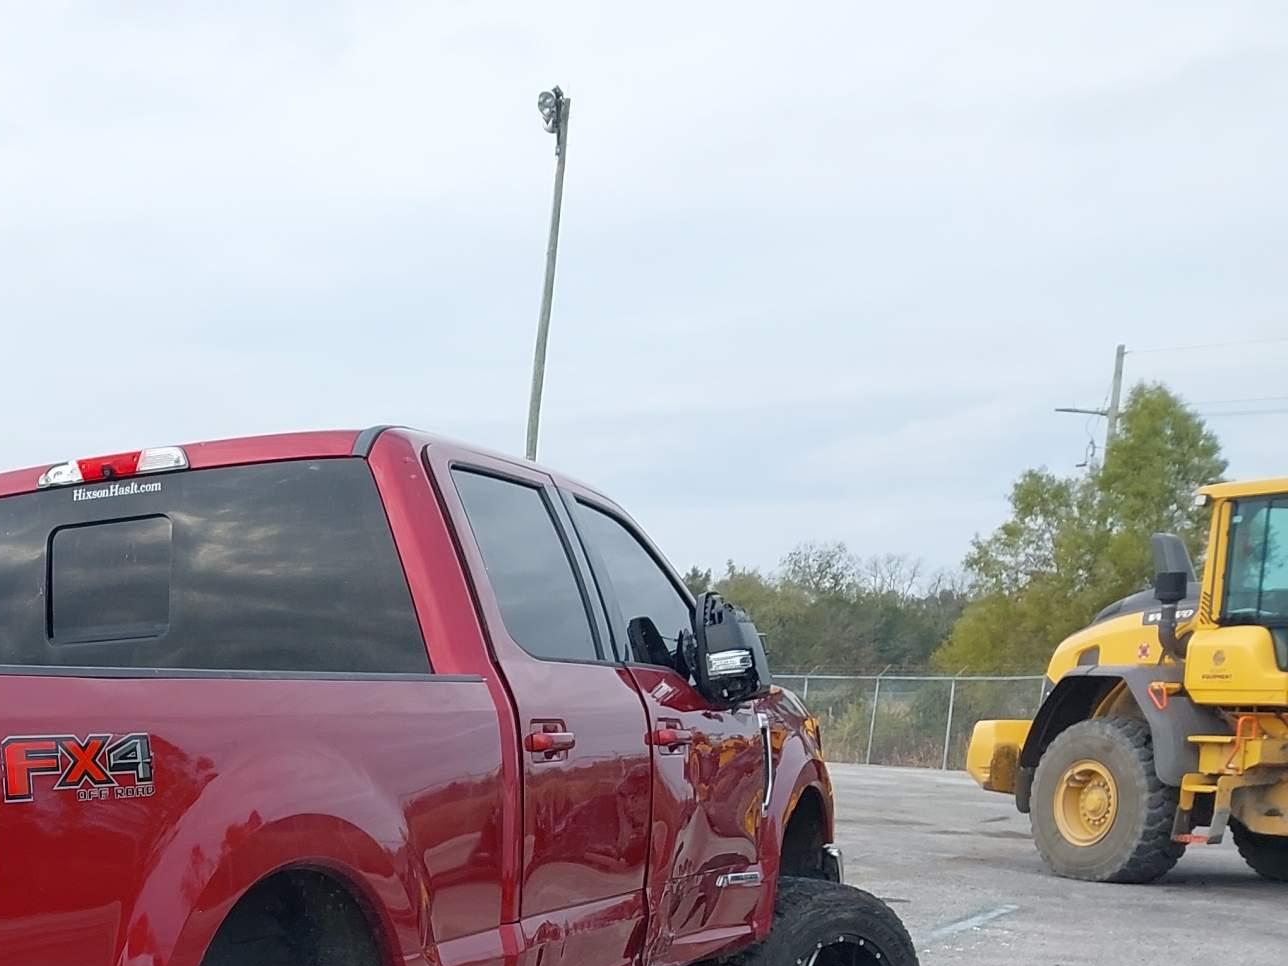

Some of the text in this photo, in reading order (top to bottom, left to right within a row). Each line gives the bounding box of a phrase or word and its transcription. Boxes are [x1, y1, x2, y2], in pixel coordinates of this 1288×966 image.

[73, 482, 162, 501] HixsonHasIt.com
[1148, 609, 1194, 622] VVO
[1, 733, 153, 803] FX4
[76, 785, 156, 801] OFF ROAD
